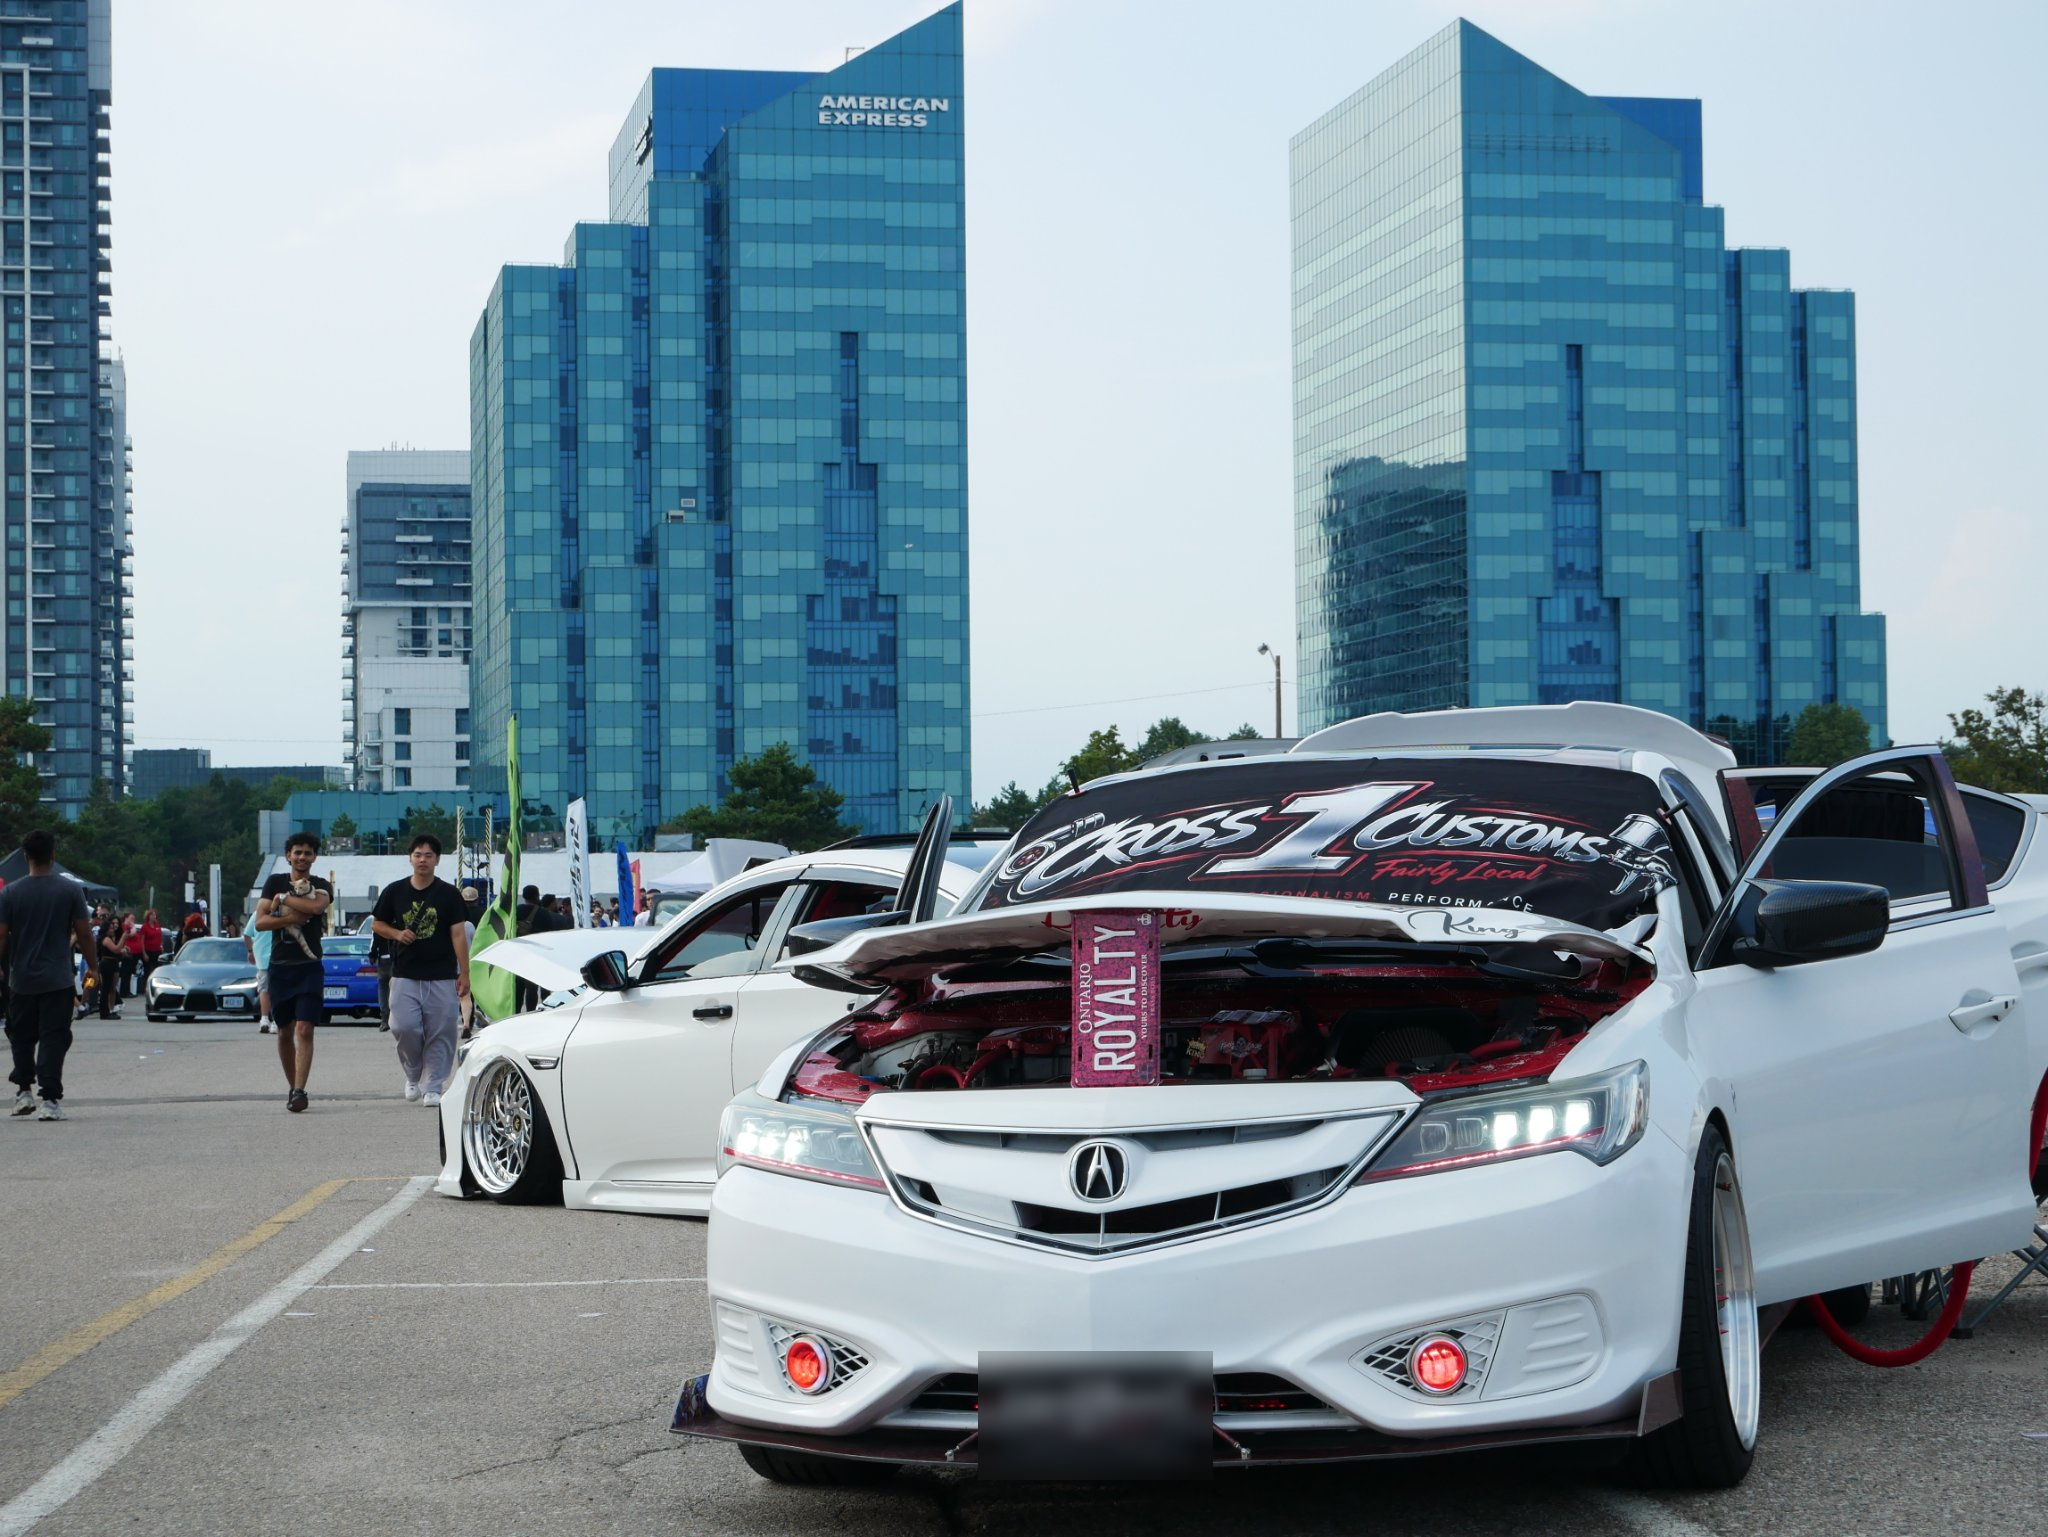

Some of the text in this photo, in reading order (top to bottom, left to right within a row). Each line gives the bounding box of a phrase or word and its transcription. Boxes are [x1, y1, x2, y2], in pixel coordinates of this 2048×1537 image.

[819, 96, 949, 111] AMERICAN
[818, 112, 928, 127] EXPRESS
[1014, 805, 1273, 897] CROSS
[1205, 783, 1420, 875] 1
[1371, 858, 1549, 885] Fairly Local
[1388, 892, 1534, 913] PERFORMCE
[1407, 910, 1526, 939] King
[1079, 963, 1093, 1034] ONTARIO
[1093, 925, 1136, 1071] ROYALTY
[1141, 997, 1148, 1009] TO
